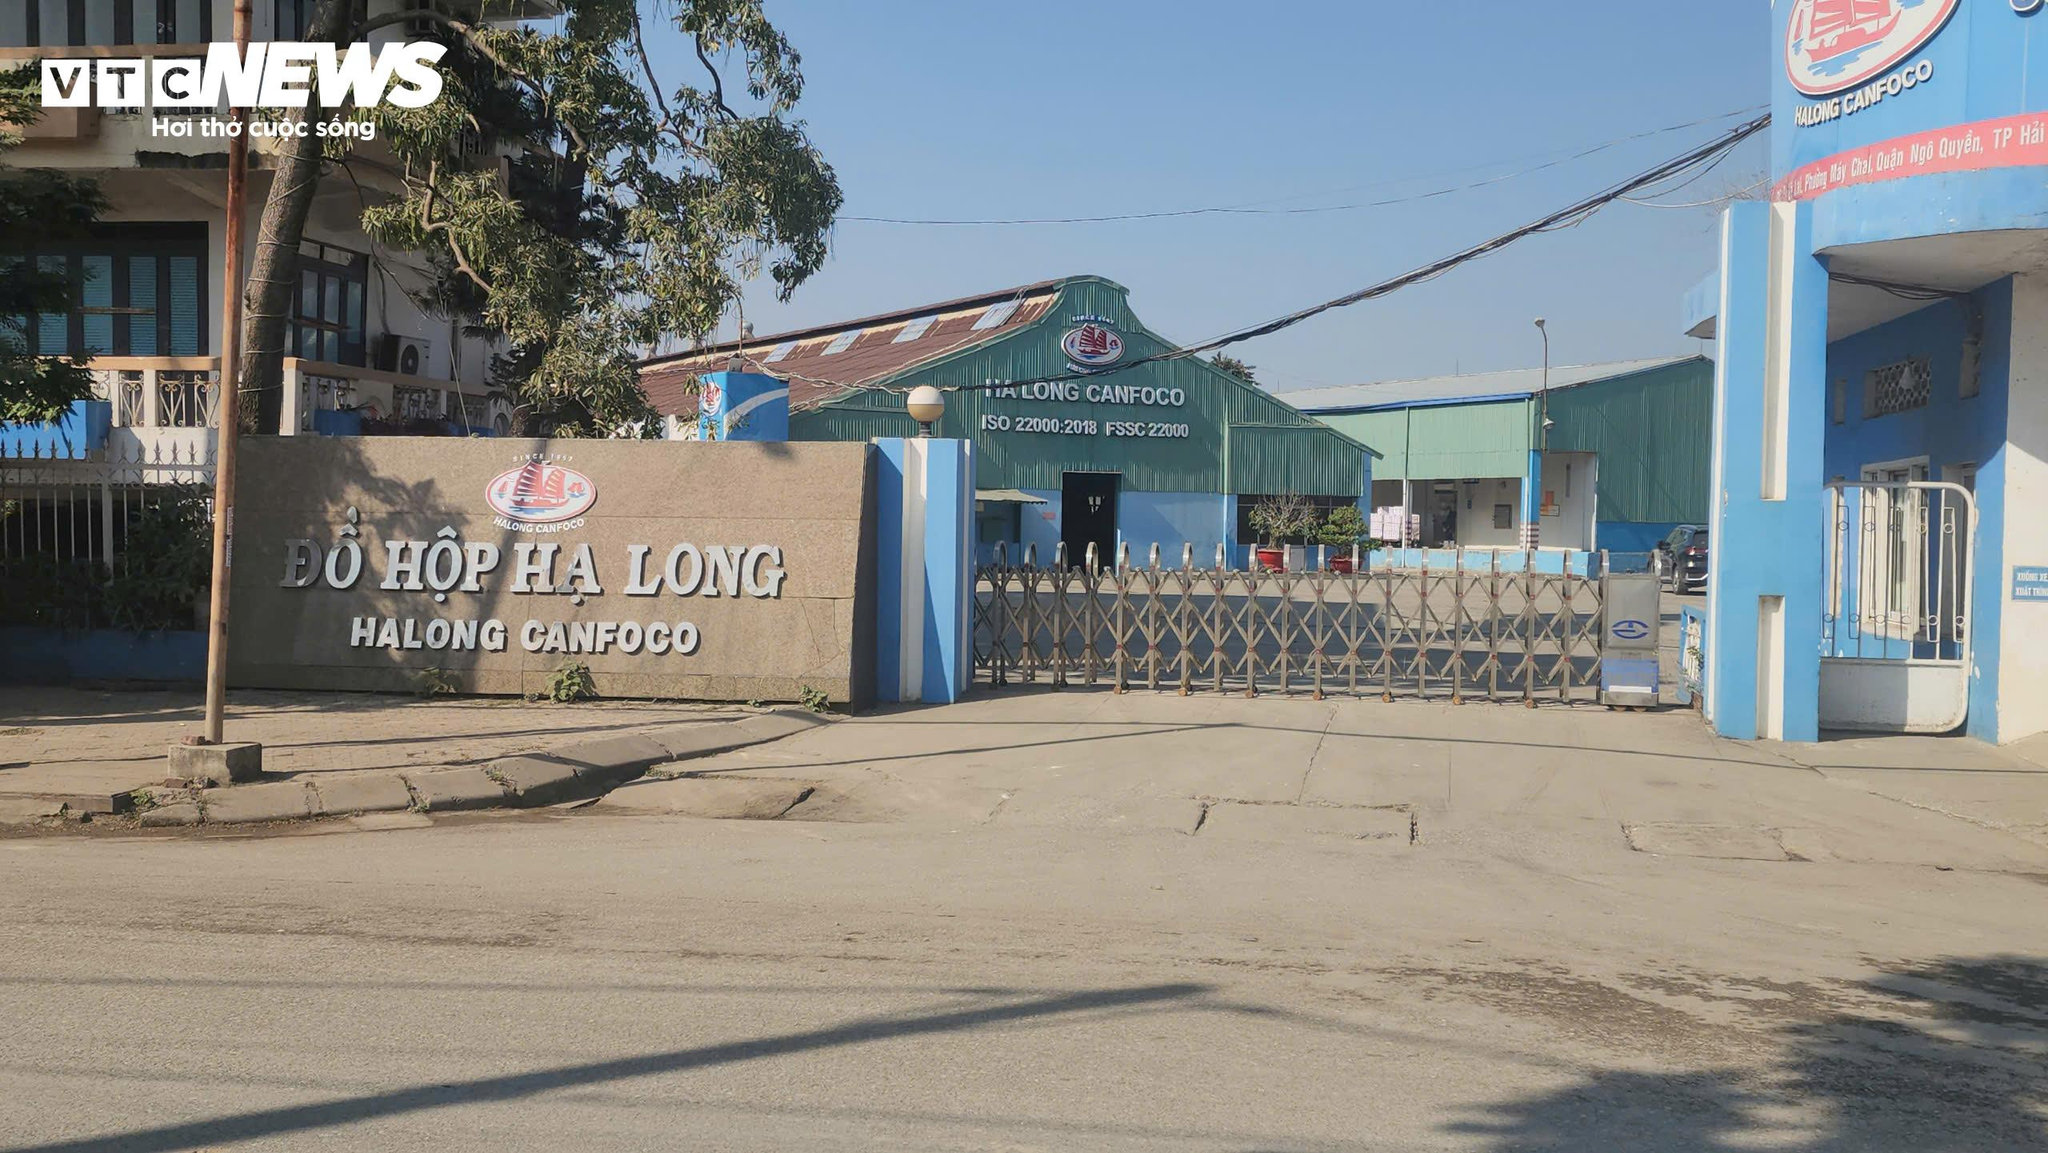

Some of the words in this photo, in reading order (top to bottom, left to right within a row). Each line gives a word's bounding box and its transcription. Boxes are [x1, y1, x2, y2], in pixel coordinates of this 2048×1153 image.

[1794, 97, 1841, 127] HALONG
[1843, 59, 1934, 115] CANFOCO
[1829, 162, 1847, 184] Máy
[1876, 147, 1904, 172] Quận
[1910, 141, 1934, 166] Ngô
[1939, 129, 1984, 159] Quyền,
[1993, 127, 2013, 149] TP
[2019, 120, 2045, 146] Hải
[1021, 381, 1080, 401] LONG
[1086, 384, 1185, 407] CANFOCO
[982, 414, 1011, 431] ISO
[1015, 416, 1098, 436] 22000:2018
[1106, 421, 1146, 438] FSSC
[1149, 422, 1190, 439] 22000
[493, 515, 534, 534] HALONG
[535, 518, 585, 534] CANFOCO
[280, 506, 363, 590] ĐỒ
[379, 525, 500, 604] HỘP
[510, 542, 602, 605] HẠ
[624, 542, 785, 598] LONG
[351, 617, 507, 651] HALONG
[520, 619, 699, 655] CANFOCO
